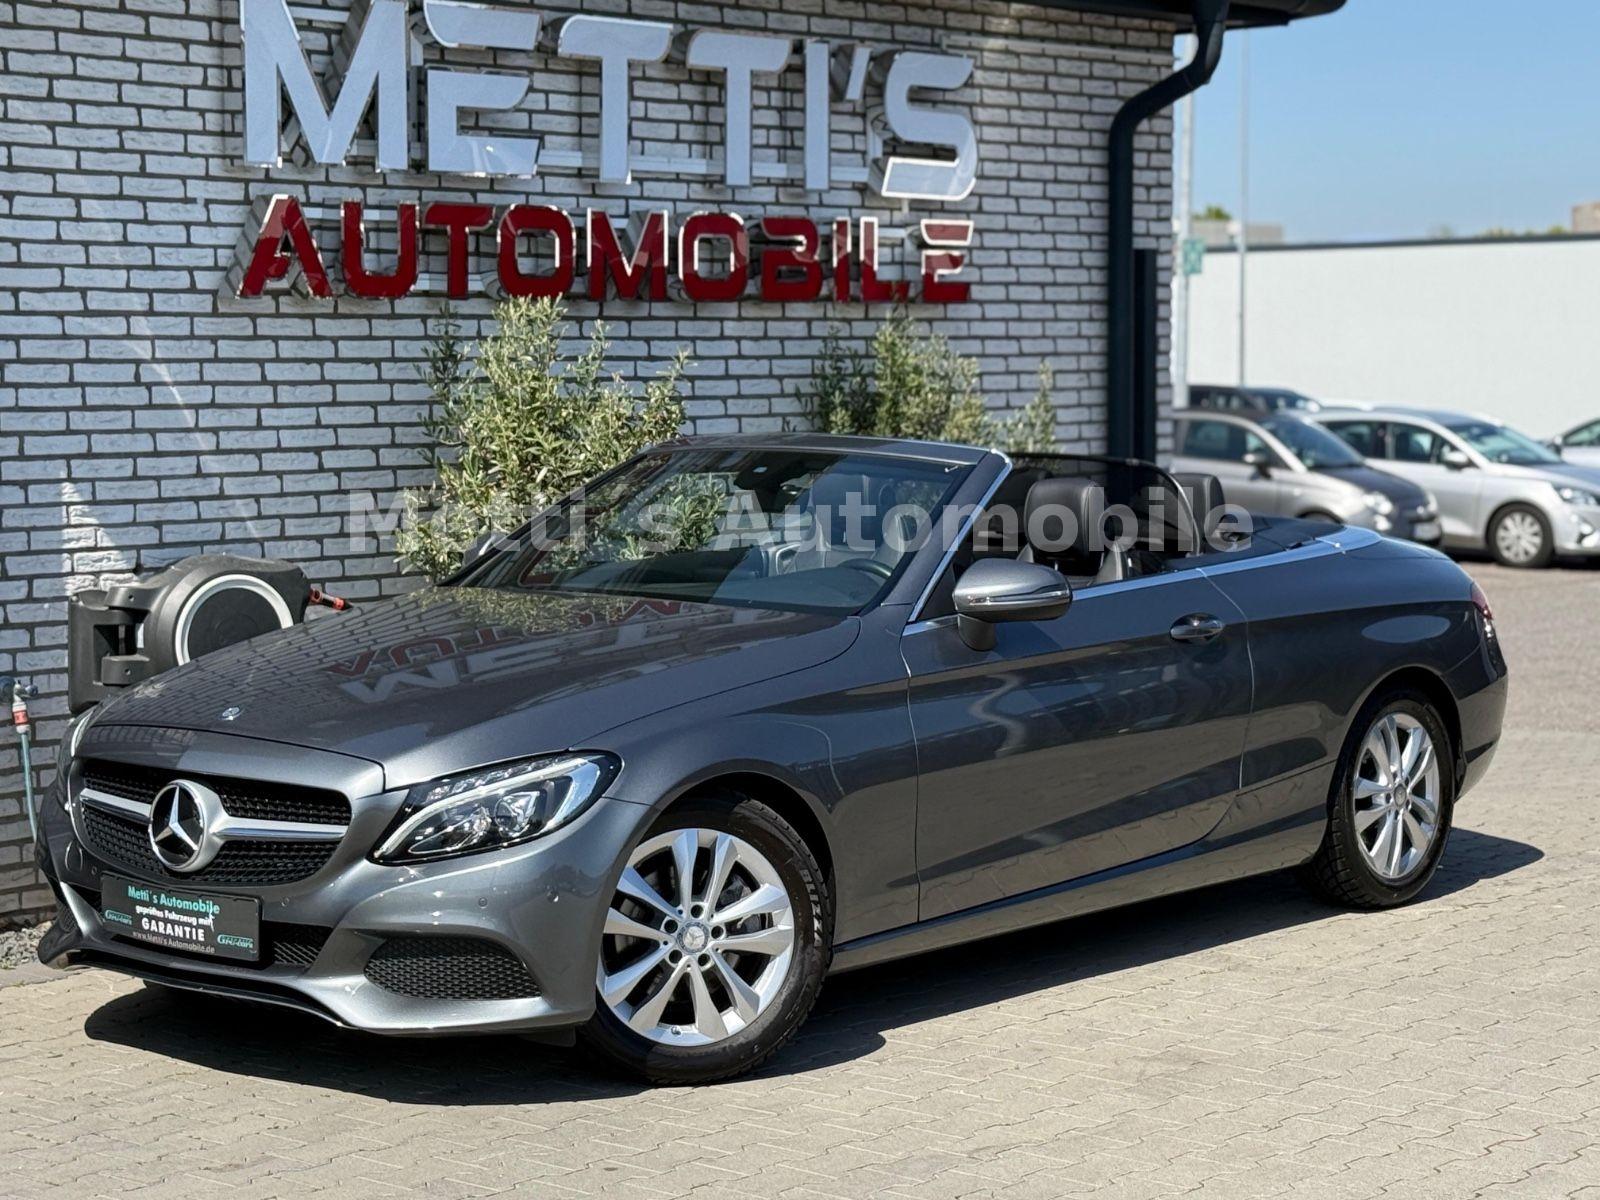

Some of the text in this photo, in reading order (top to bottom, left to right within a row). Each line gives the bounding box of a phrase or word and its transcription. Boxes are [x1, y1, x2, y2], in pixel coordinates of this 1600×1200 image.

[241, 0, 978, 201] METTI'S
[238, 193, 975, 302] AUTOMOBILE
[141, 917, 205, 942] GARANTIE
[160, 893, 220, 915] Automobile
